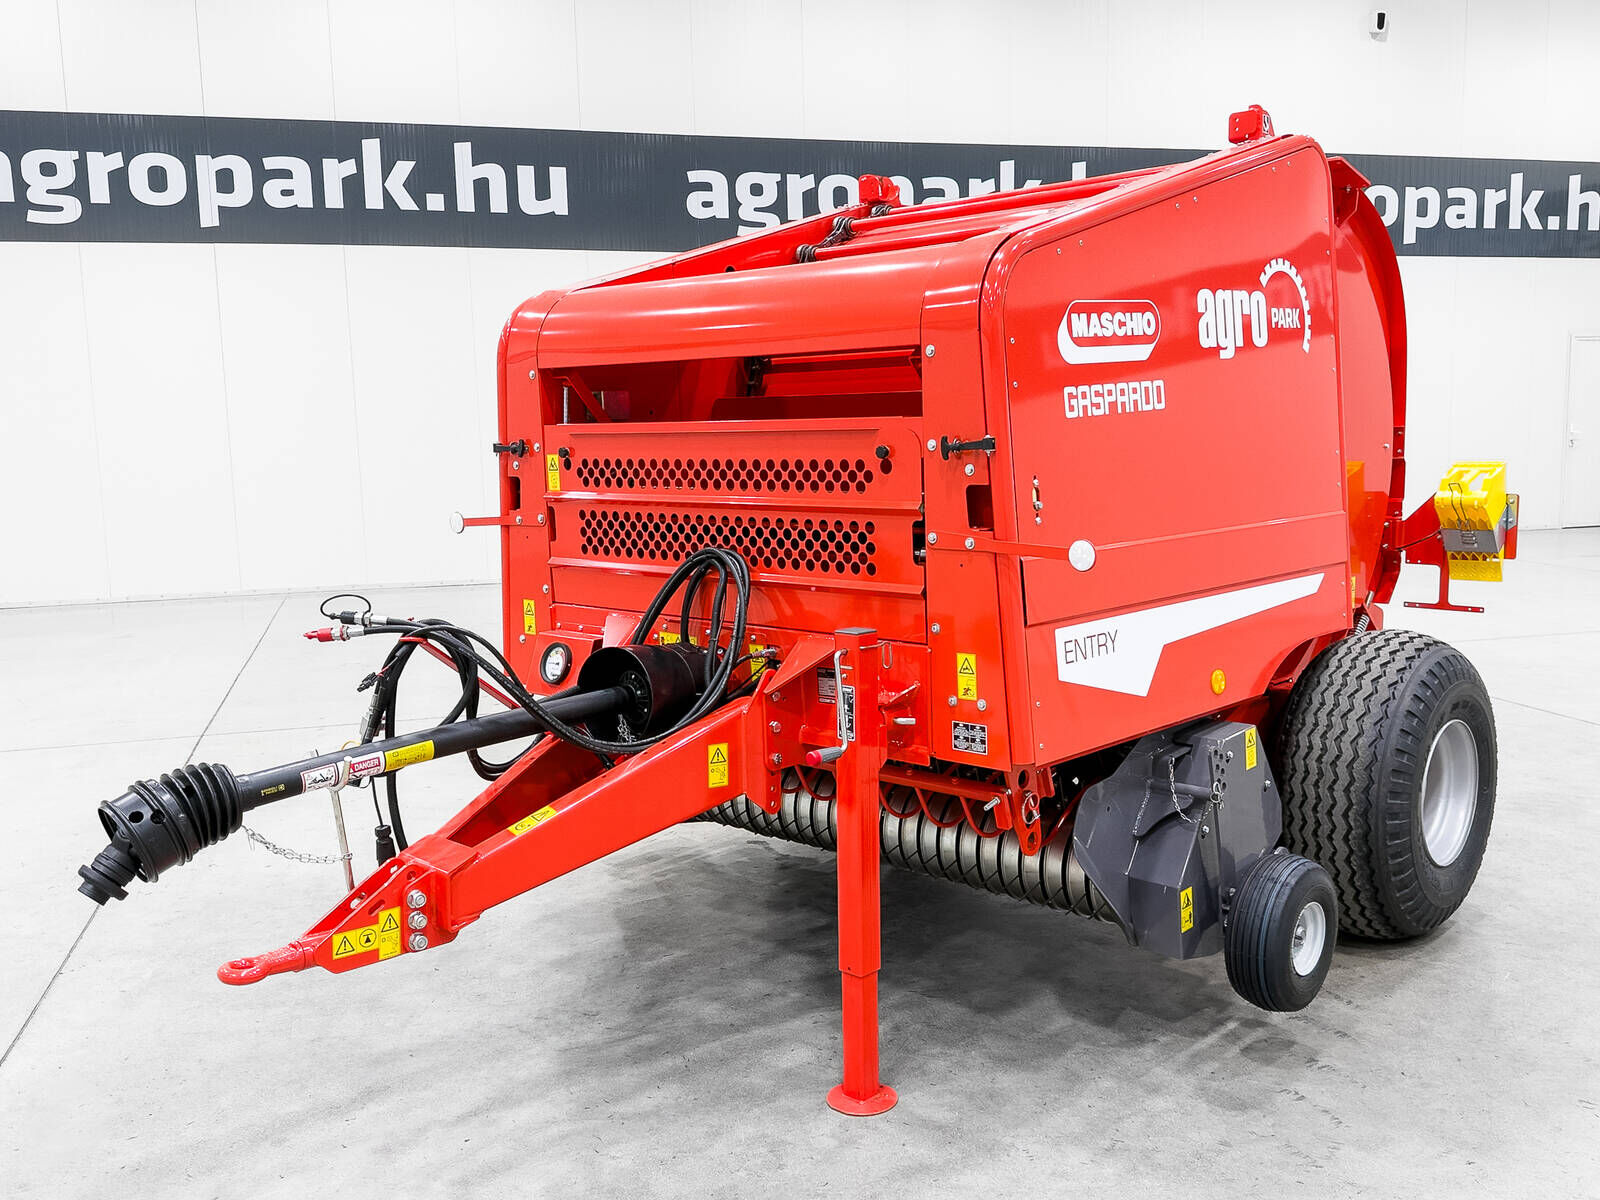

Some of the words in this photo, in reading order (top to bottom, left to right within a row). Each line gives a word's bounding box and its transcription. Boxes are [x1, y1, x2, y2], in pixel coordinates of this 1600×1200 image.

[1071, 312, 1155, 337] MASCHIO
[1197, 288, 1268, 359] agro
[1271, 308, 1301, 329] PARK
[1064, 379, 1166, 418] GASPARDO
[1064, 629, 1119, 665] ENTRY
[354, 759, 379, 771] DANGER
